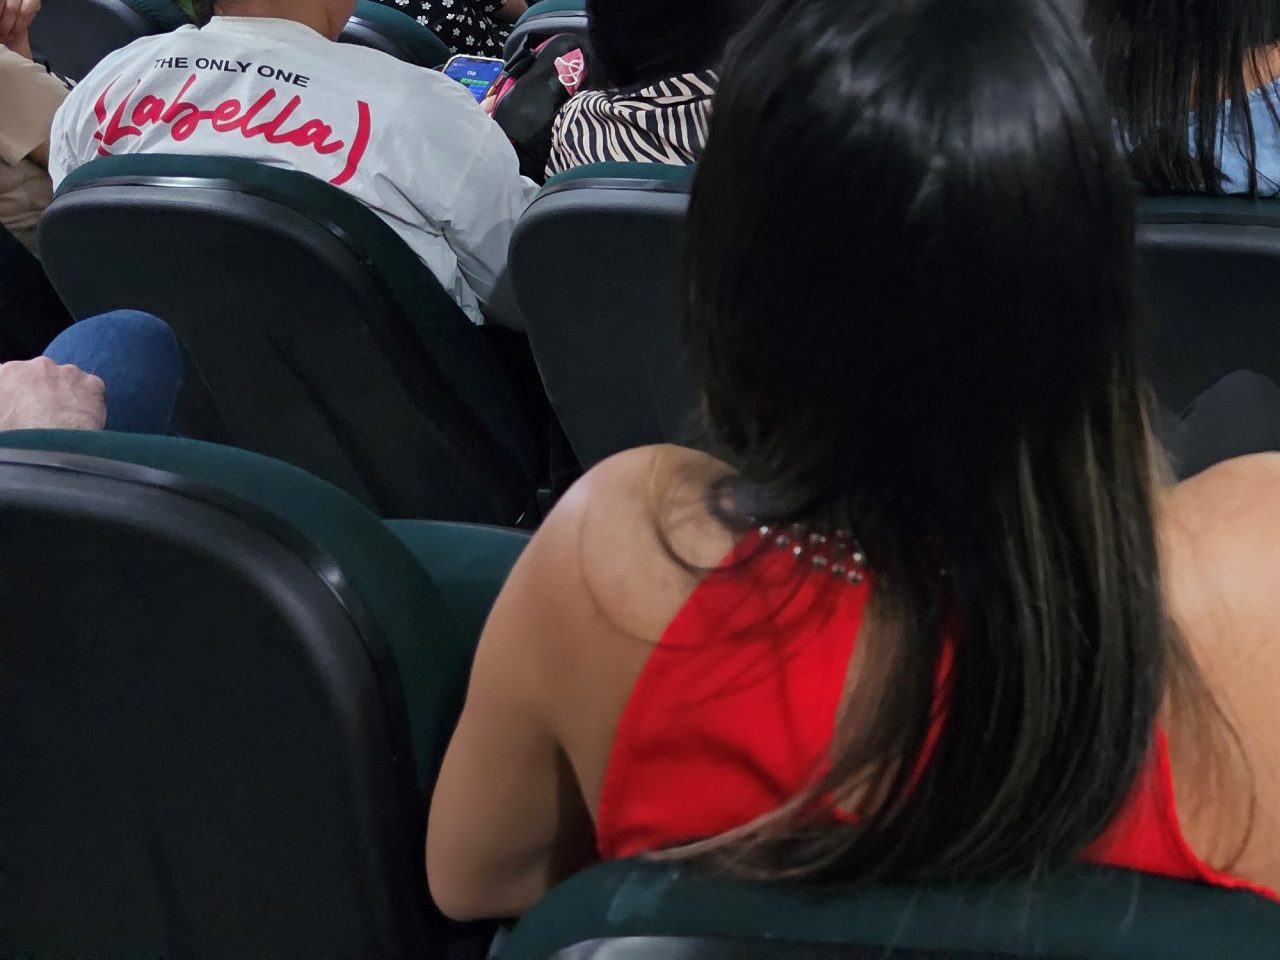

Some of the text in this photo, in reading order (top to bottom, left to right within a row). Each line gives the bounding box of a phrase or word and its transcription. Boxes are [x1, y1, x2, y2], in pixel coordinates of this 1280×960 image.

[153, 56, 311, 88] THE ONLY ONE
